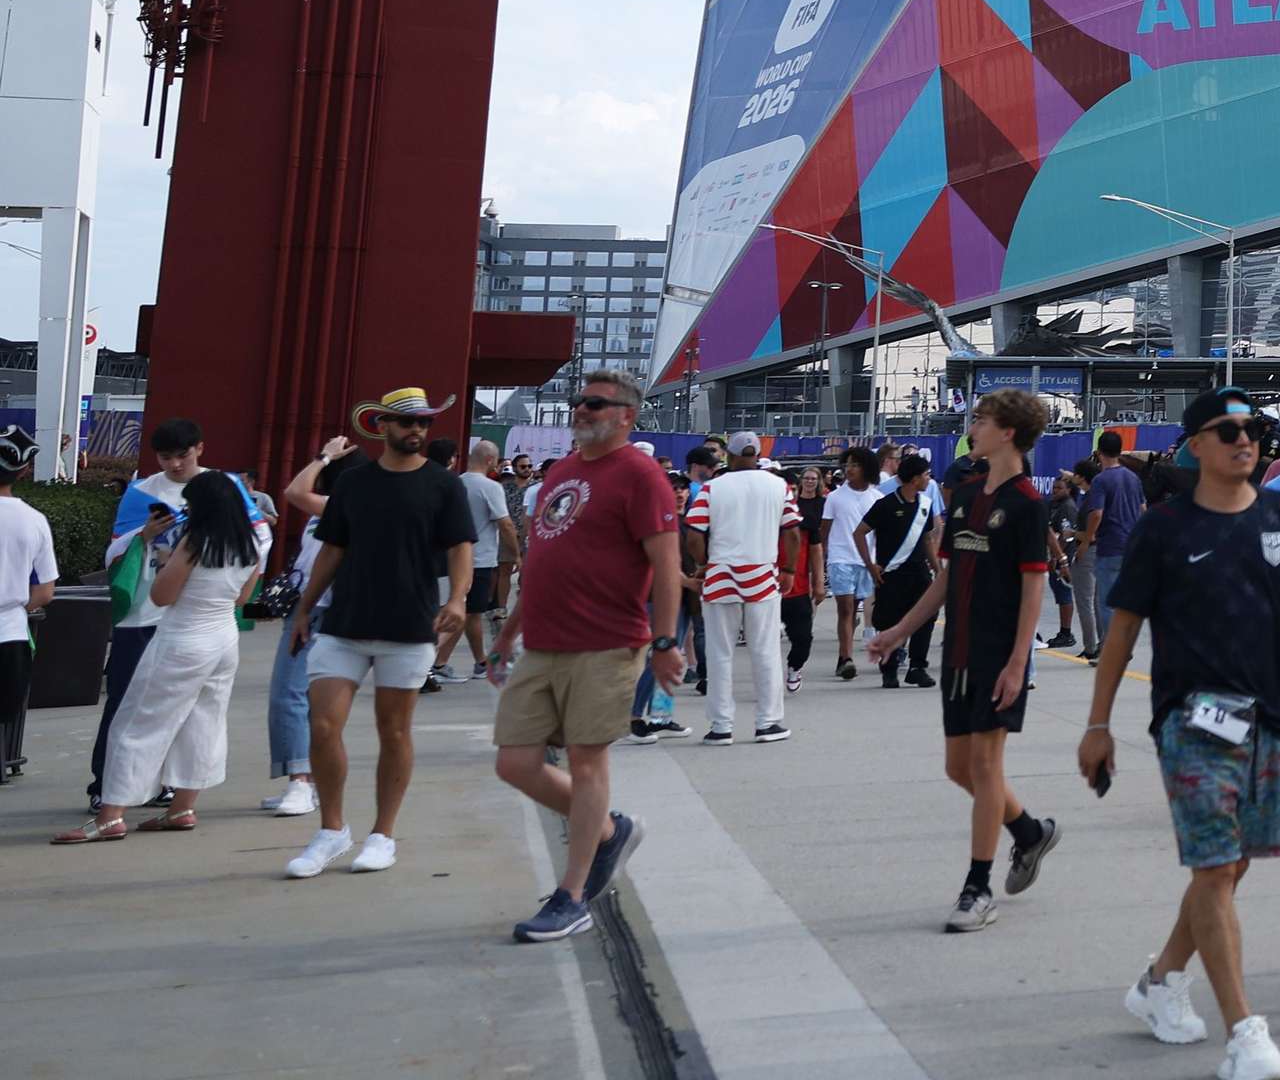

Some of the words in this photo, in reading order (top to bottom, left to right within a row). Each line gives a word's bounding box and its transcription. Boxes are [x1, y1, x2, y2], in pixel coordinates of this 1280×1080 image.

[791, 0, 820, 30] FIFA
[755, 61, 792, 89] WORLD
[789, 51, 813, 78] CUP
[737, 78, 800, 129] 2026
[1056, 376, 1079, 385] LANE
